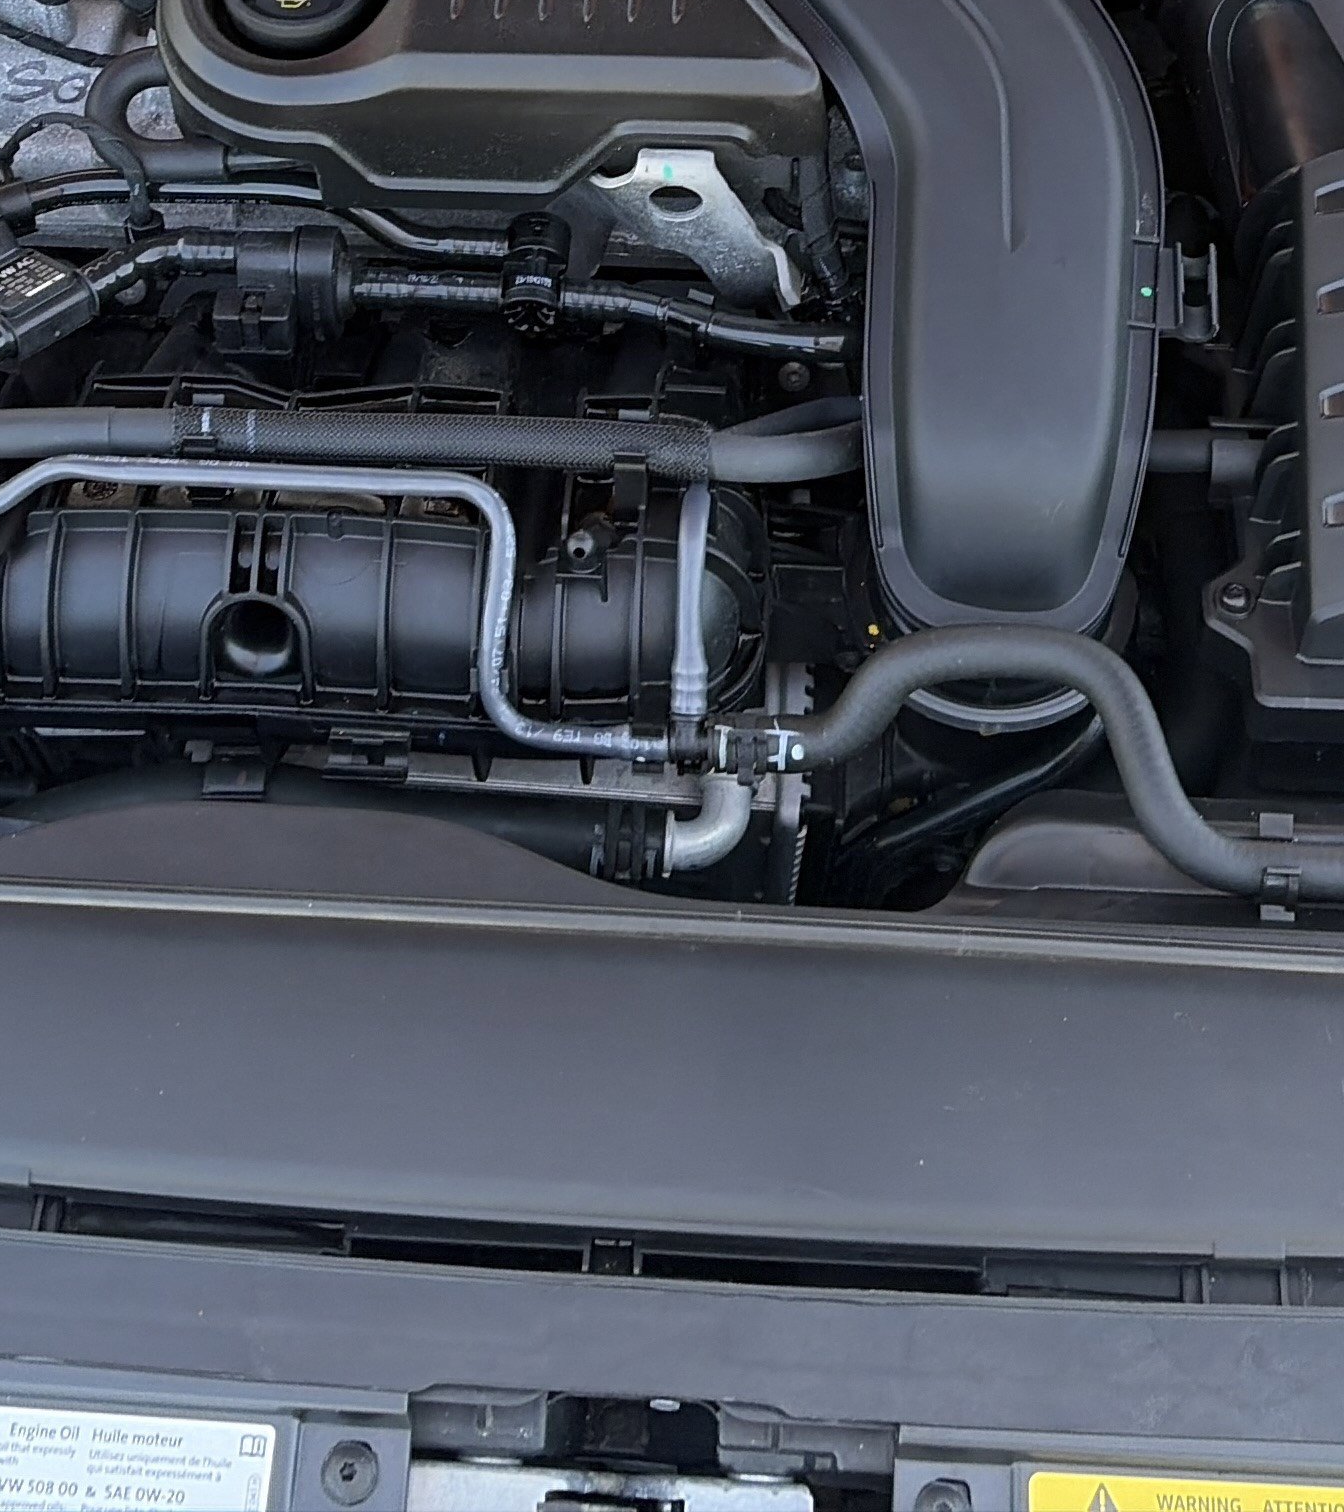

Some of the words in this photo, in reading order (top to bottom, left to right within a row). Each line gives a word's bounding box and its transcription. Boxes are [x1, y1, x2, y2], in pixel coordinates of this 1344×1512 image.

[9, 1422, 57, 1441] Engine
[59, 1425, 81, 1441] Oil
[91, 1428, 128, 1444] Huile
[131, 1432, 184, 1448] moteur
[32, 1445, 76, 1458] expressly
[127, 1451, 186, 1466] uniquement
[189, 1455, 200, 1465] de
[86, 1465, 103, 1476] qui
[105, 1464, 143, 1476] satisfait
[145, 1468, 213, 1481] expressément
[28, 1479, 54, 1495] 508
[58, 1481, 79, 1497] 00
[85, 1485, 97, 1497] &
[104, 1484, 132, 1500] SAE
[135, 1486, 186, 1505] 0W-20
[1156, 1493, 1241, 1512] WARNING
